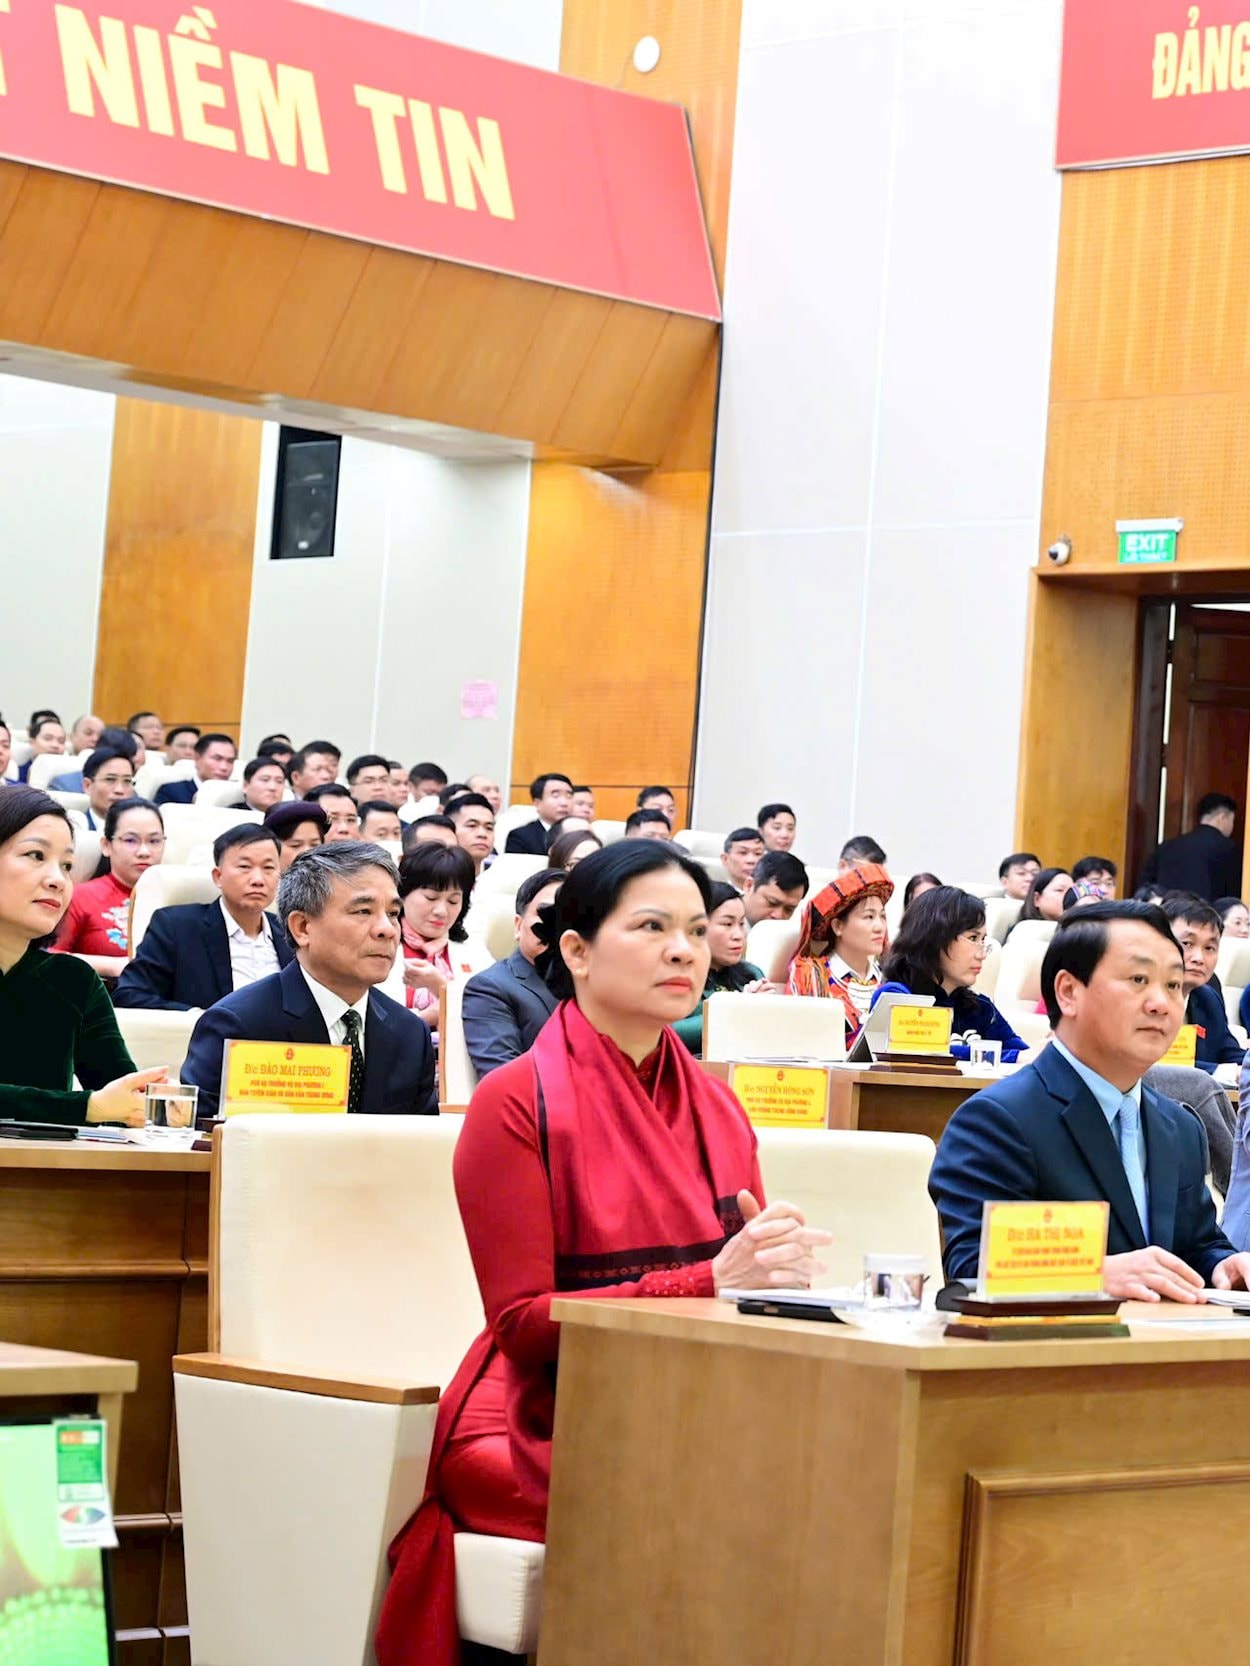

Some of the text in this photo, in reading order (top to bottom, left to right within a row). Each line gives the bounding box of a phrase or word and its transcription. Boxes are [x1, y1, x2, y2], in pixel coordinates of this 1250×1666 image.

[55, 3, 330, 176] NIỀM
[353, 83, 516, 221] TIN
[1126, 533, 1169, 551] EXIT
[260, 1062, 279, 1075] ĐÀO
[279, 1064, 297, 1077] MAI
[297, 1065, 331, 1077] PHƯƠNG
